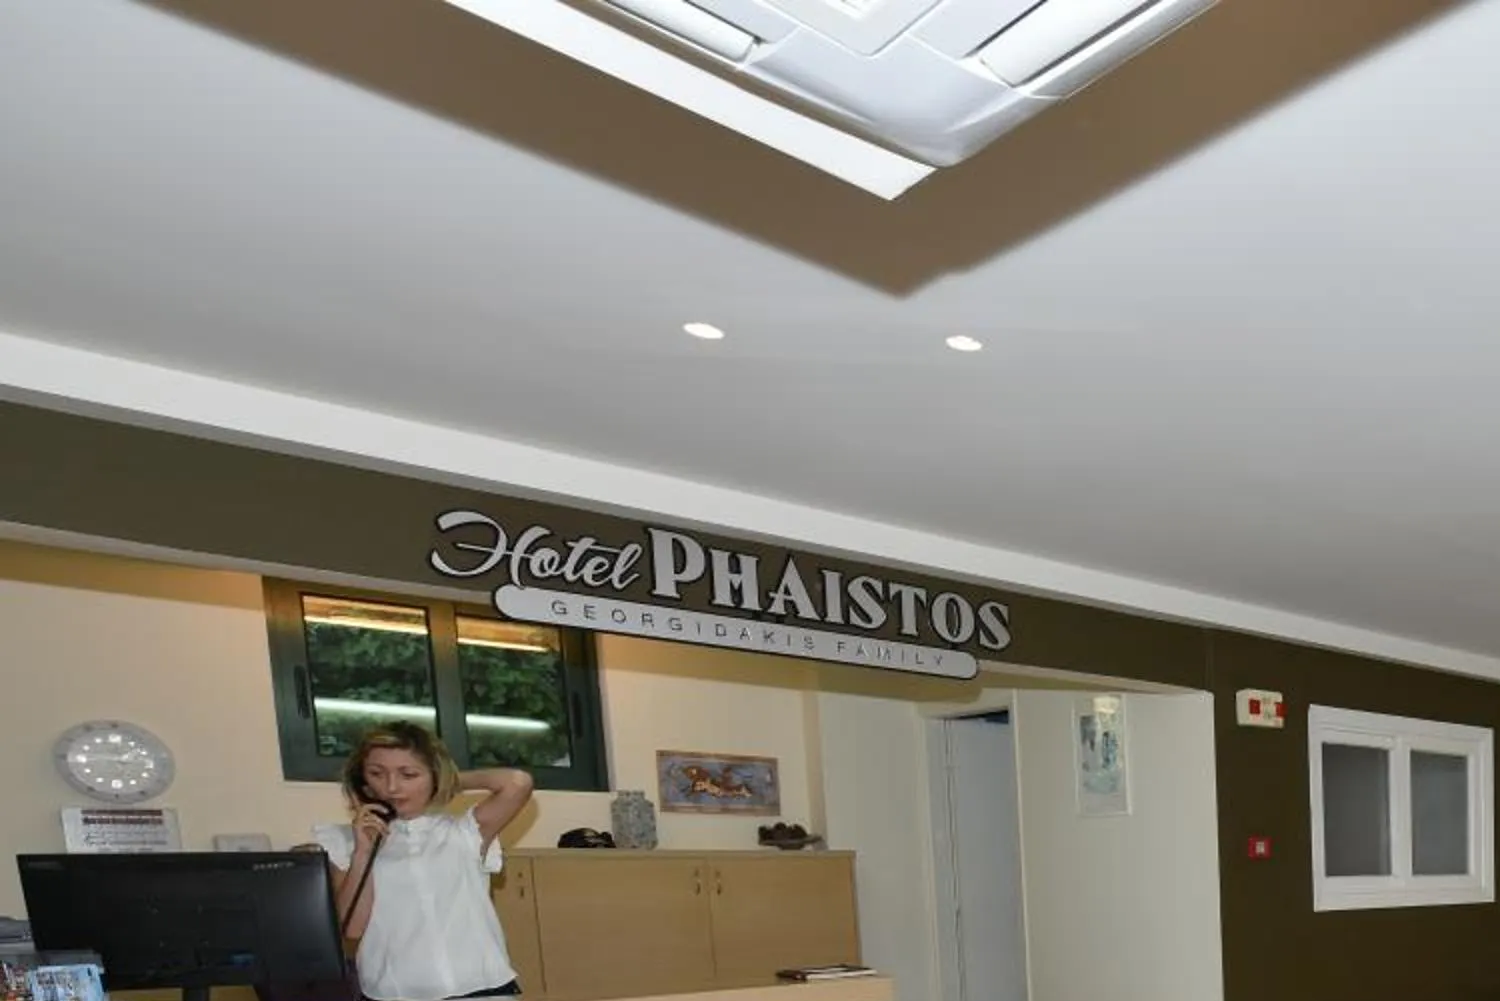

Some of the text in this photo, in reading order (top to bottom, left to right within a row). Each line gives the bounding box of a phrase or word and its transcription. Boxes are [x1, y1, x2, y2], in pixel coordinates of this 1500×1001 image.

[431, 510, 1011, 650] Hotel PHAISTOS
[551, 600, 944, 667] GEORGIDAKIS FAMILY
